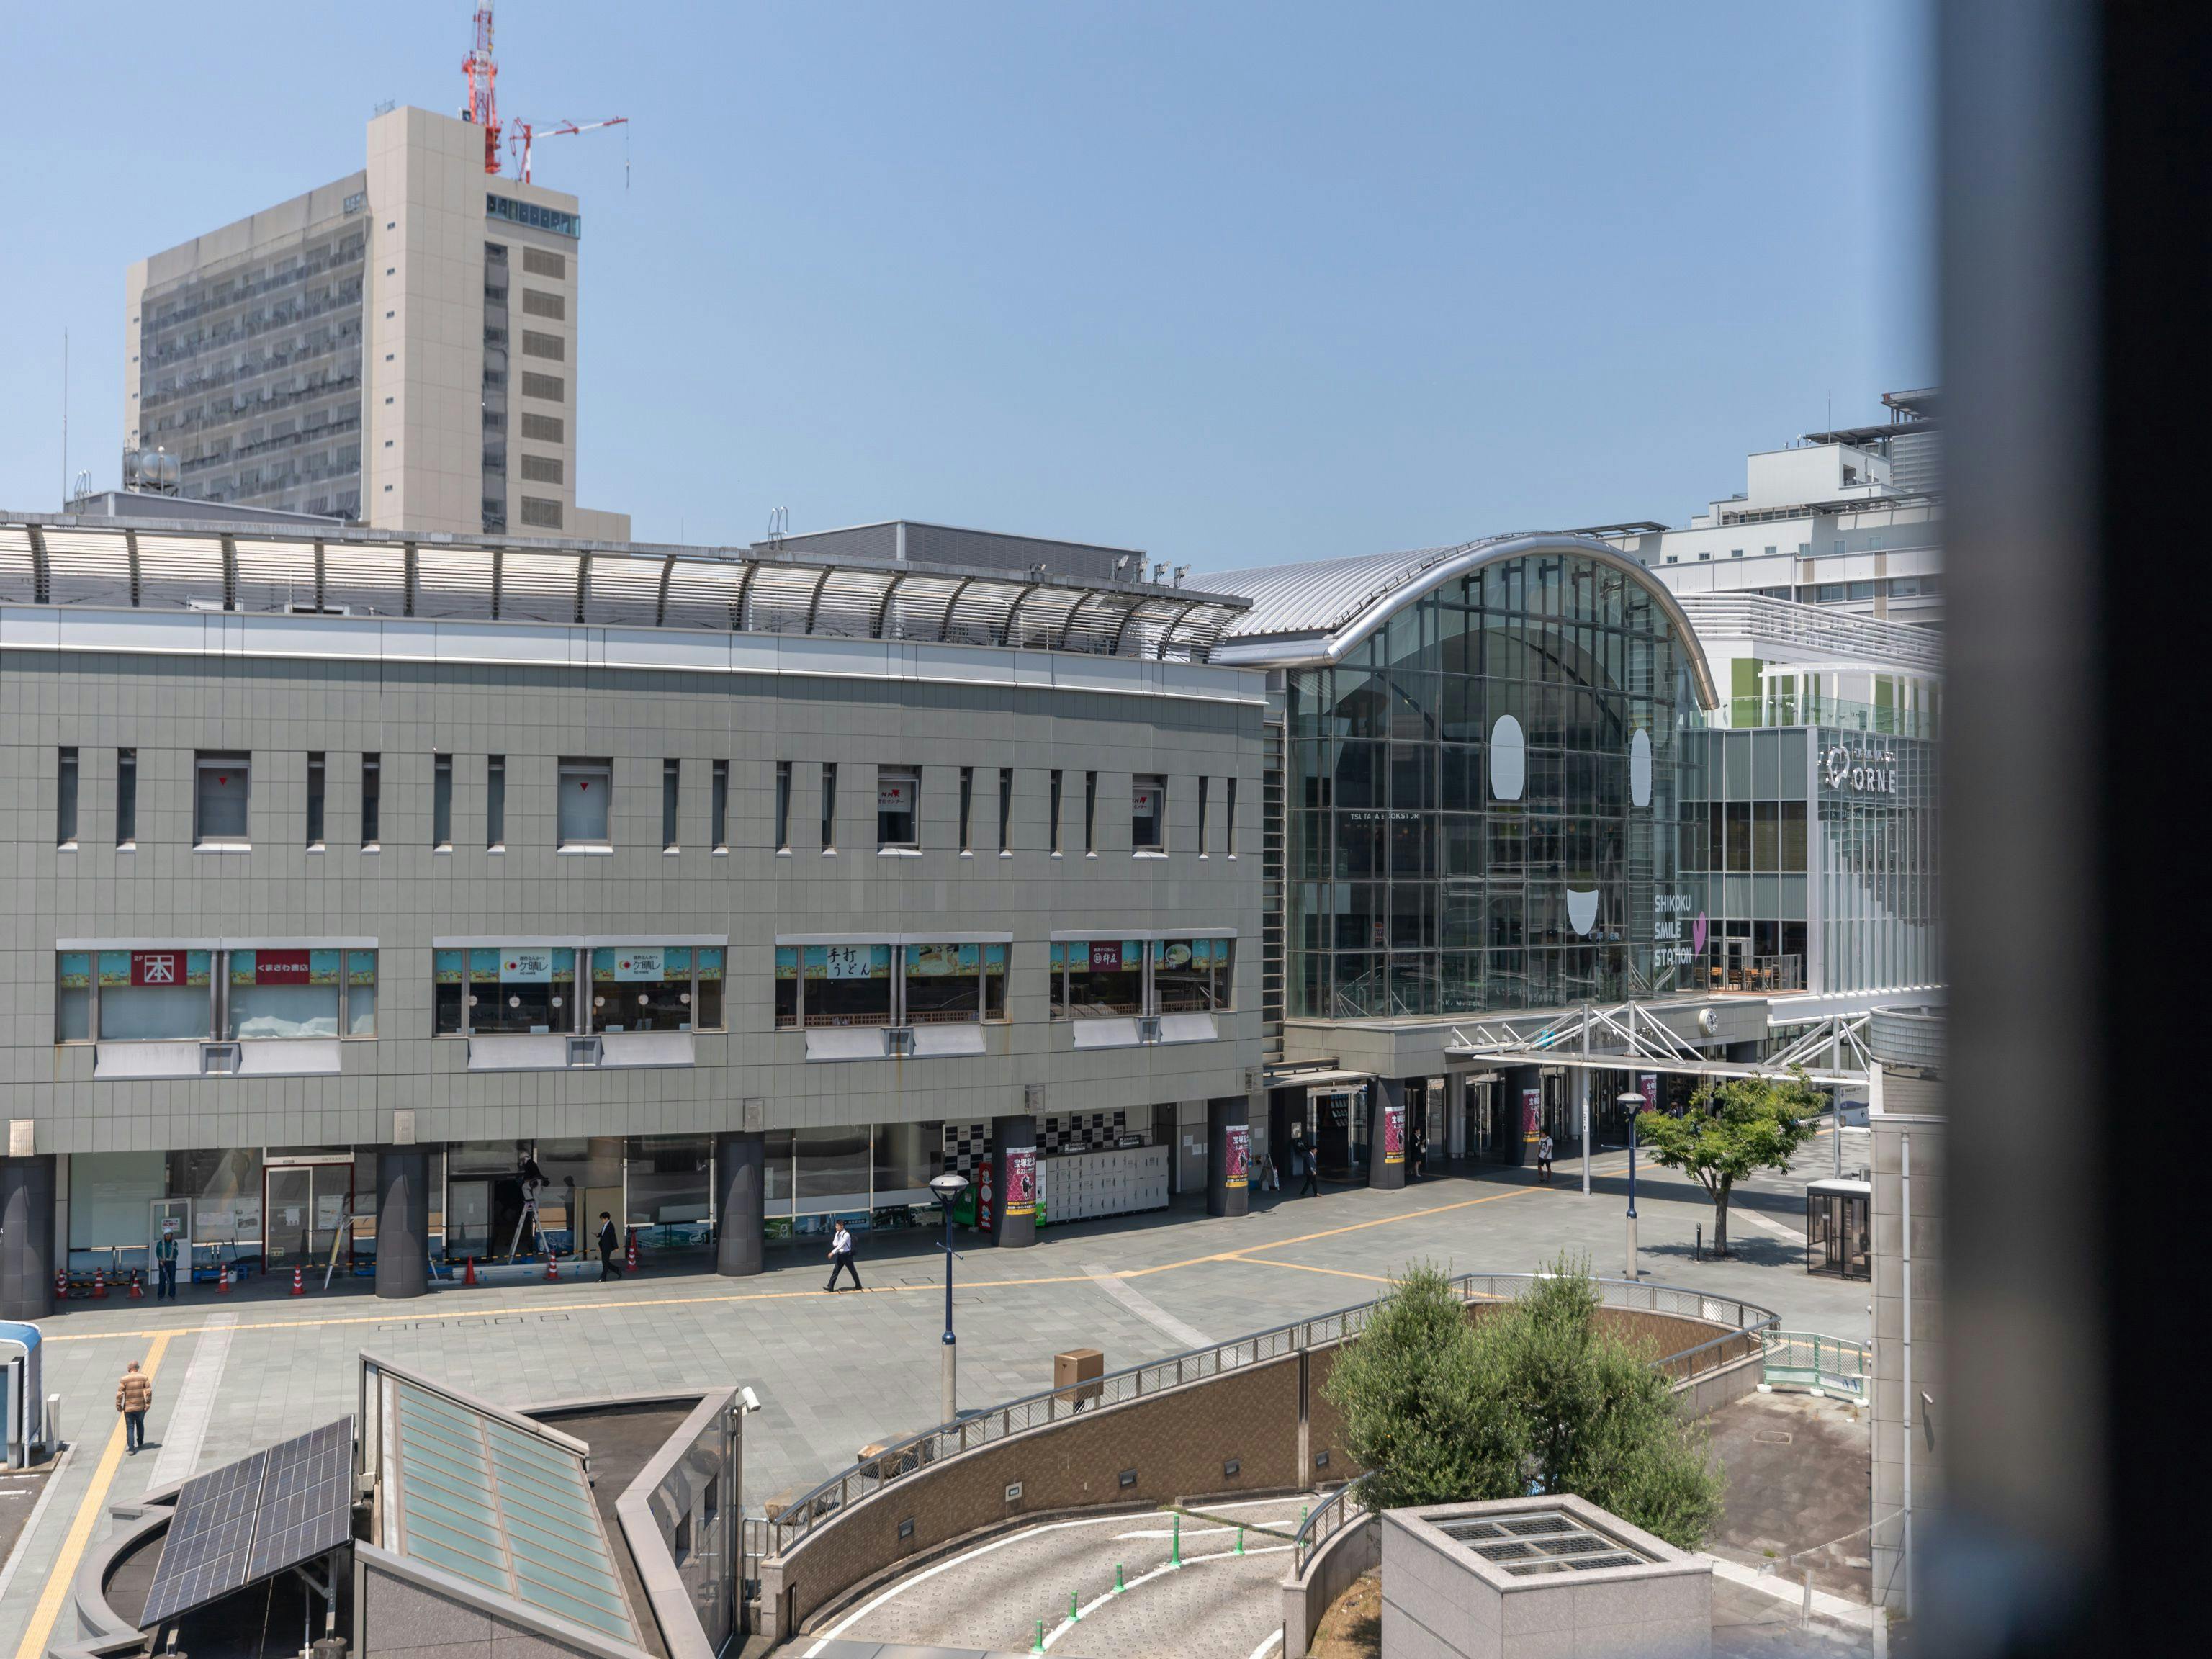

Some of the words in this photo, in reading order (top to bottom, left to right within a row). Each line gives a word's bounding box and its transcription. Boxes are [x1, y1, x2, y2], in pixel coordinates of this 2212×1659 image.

[1854, 767, 1895, 793] ORNE
[1655, 894, 1691, 912] SHIKOKU
[1655, 921, 1681, 940] SMILE
[827, 947, 856, 963] 手打
[1655, 947, 1691, 967] STATION
[144, 955, 174, 982] 本
[834, 963, 871, 977] うどん
